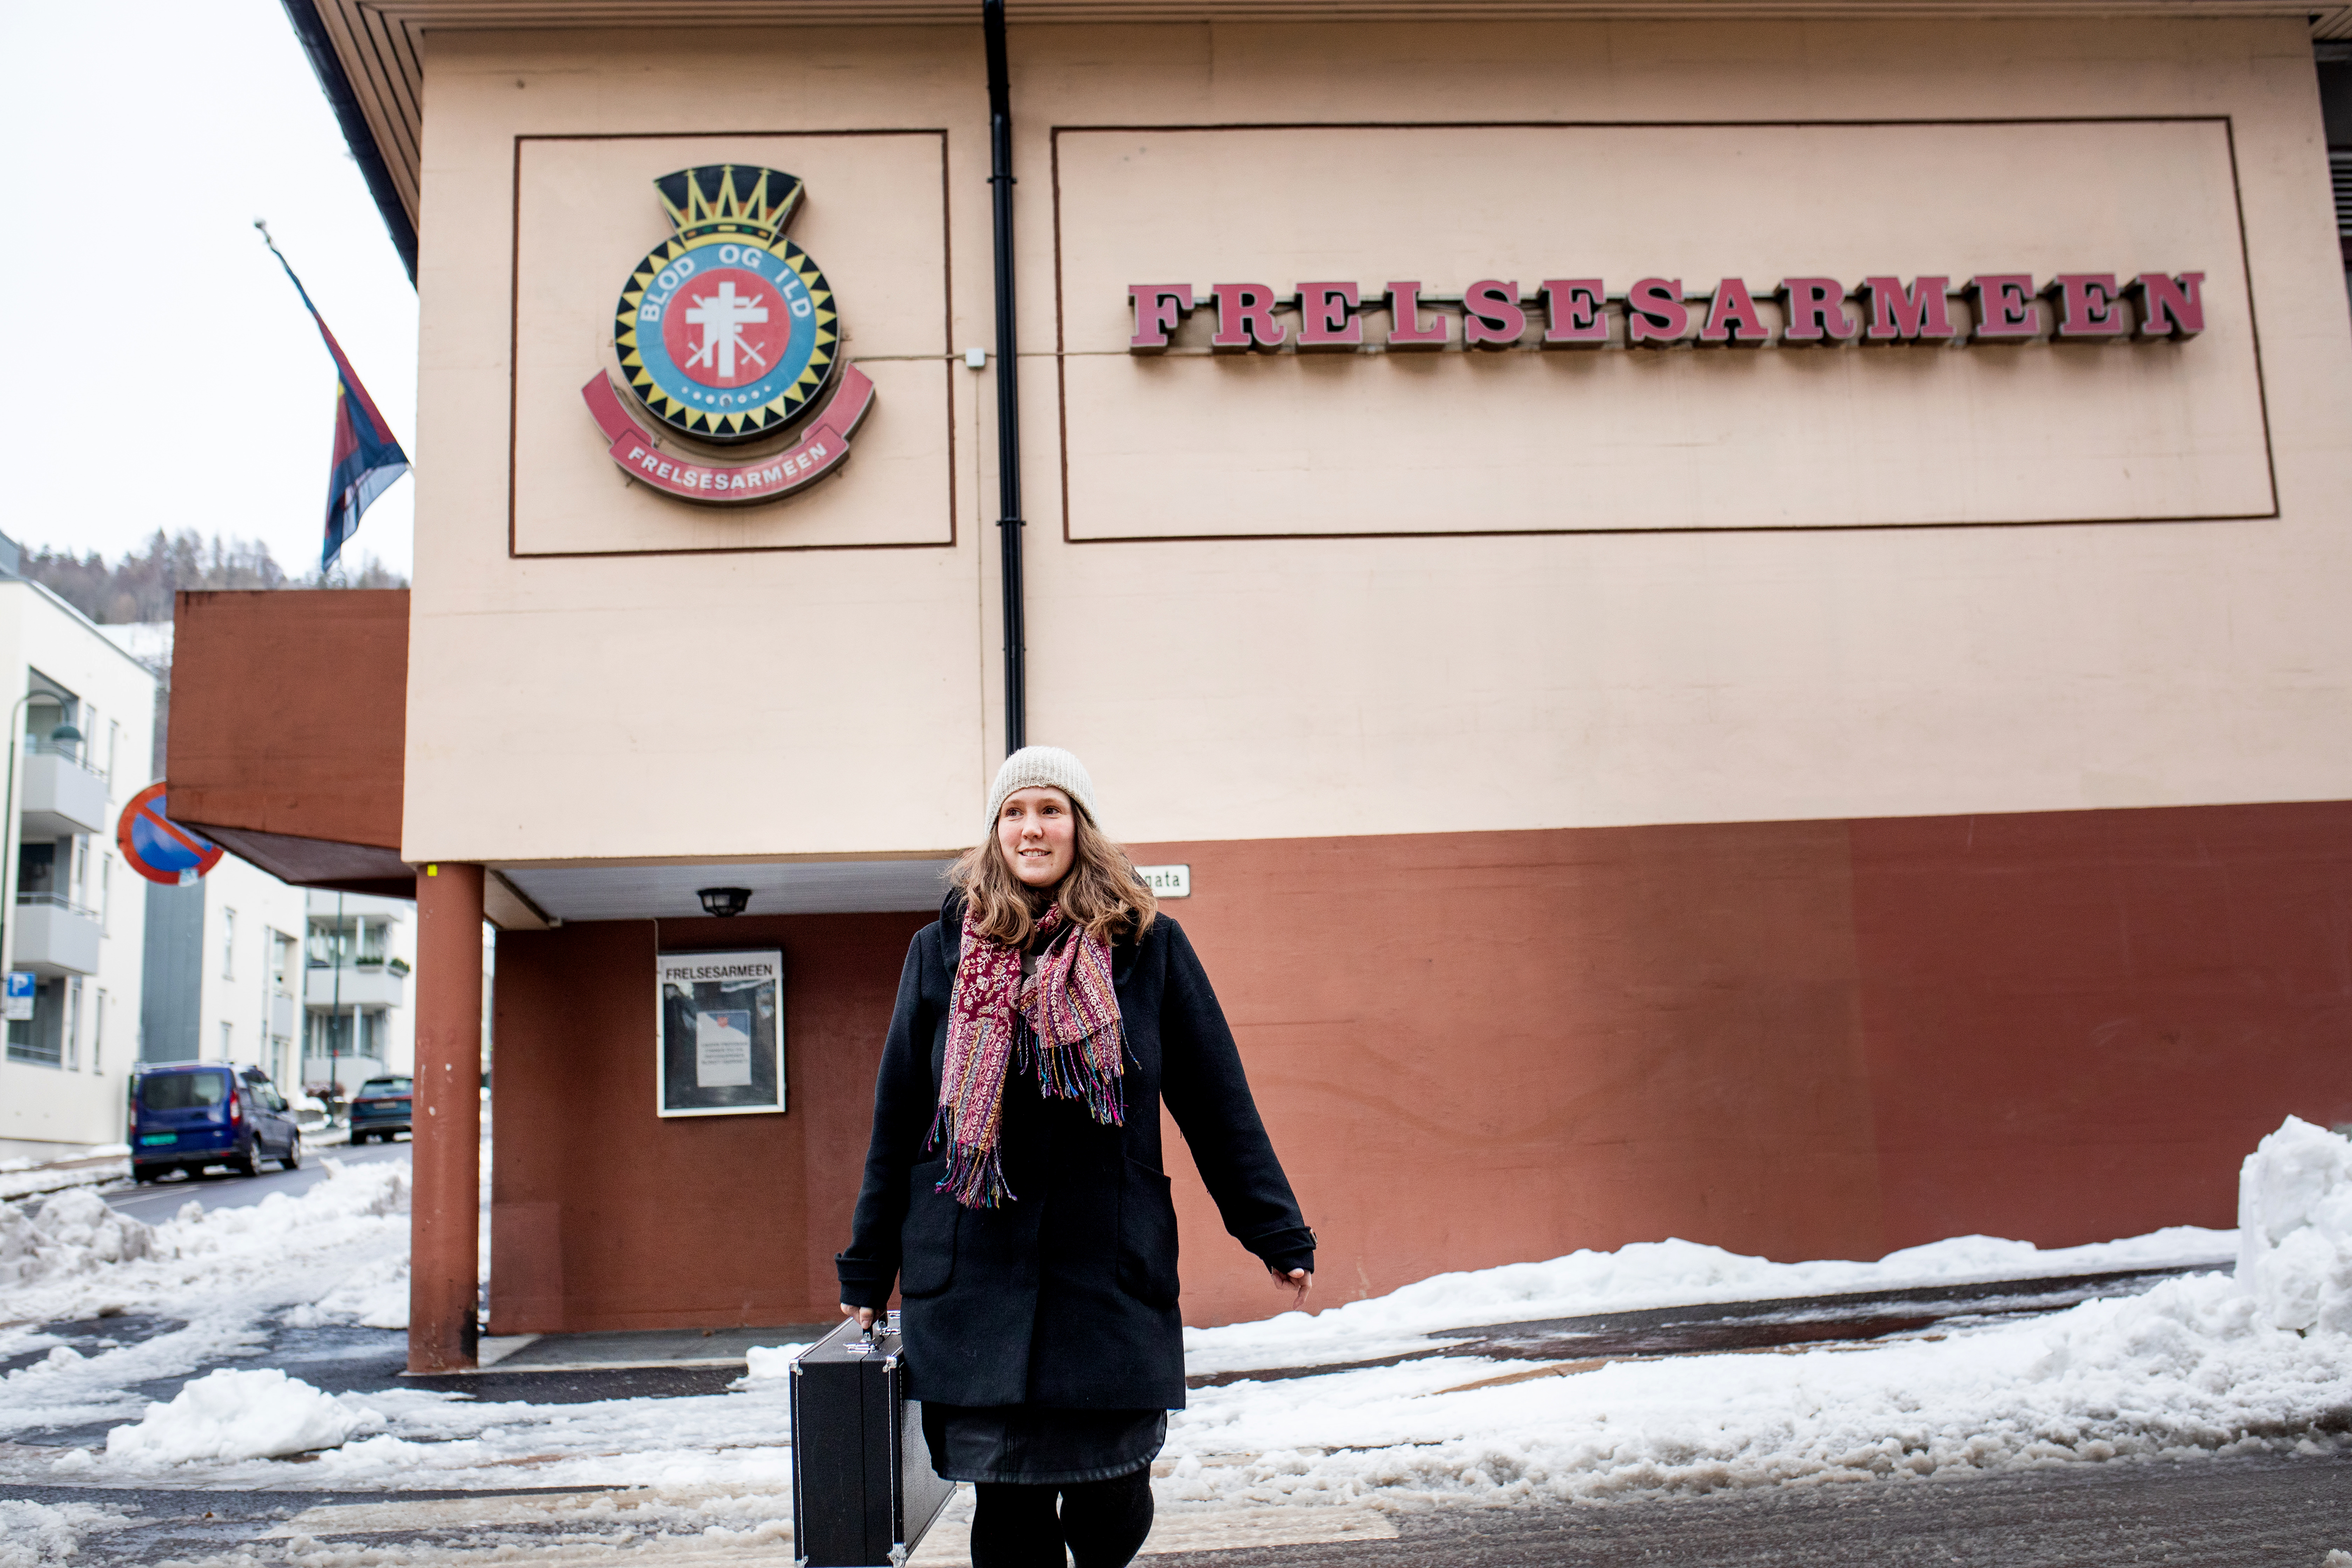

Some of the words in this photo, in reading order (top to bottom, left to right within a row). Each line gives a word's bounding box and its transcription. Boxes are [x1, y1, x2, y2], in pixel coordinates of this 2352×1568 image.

[640, 256, 695, 322] BLOD
[718, 244, 762, 268] OG
[774, 268, 812, 319] ILD
[1128, 272, 2206, 349] FRELSESARMEEN
[628, 443, 827, 490] FRELSESARMEEN
[12, 974, 29, 996] P
[666, 963, 773, 980] FRELSESARMEEN
